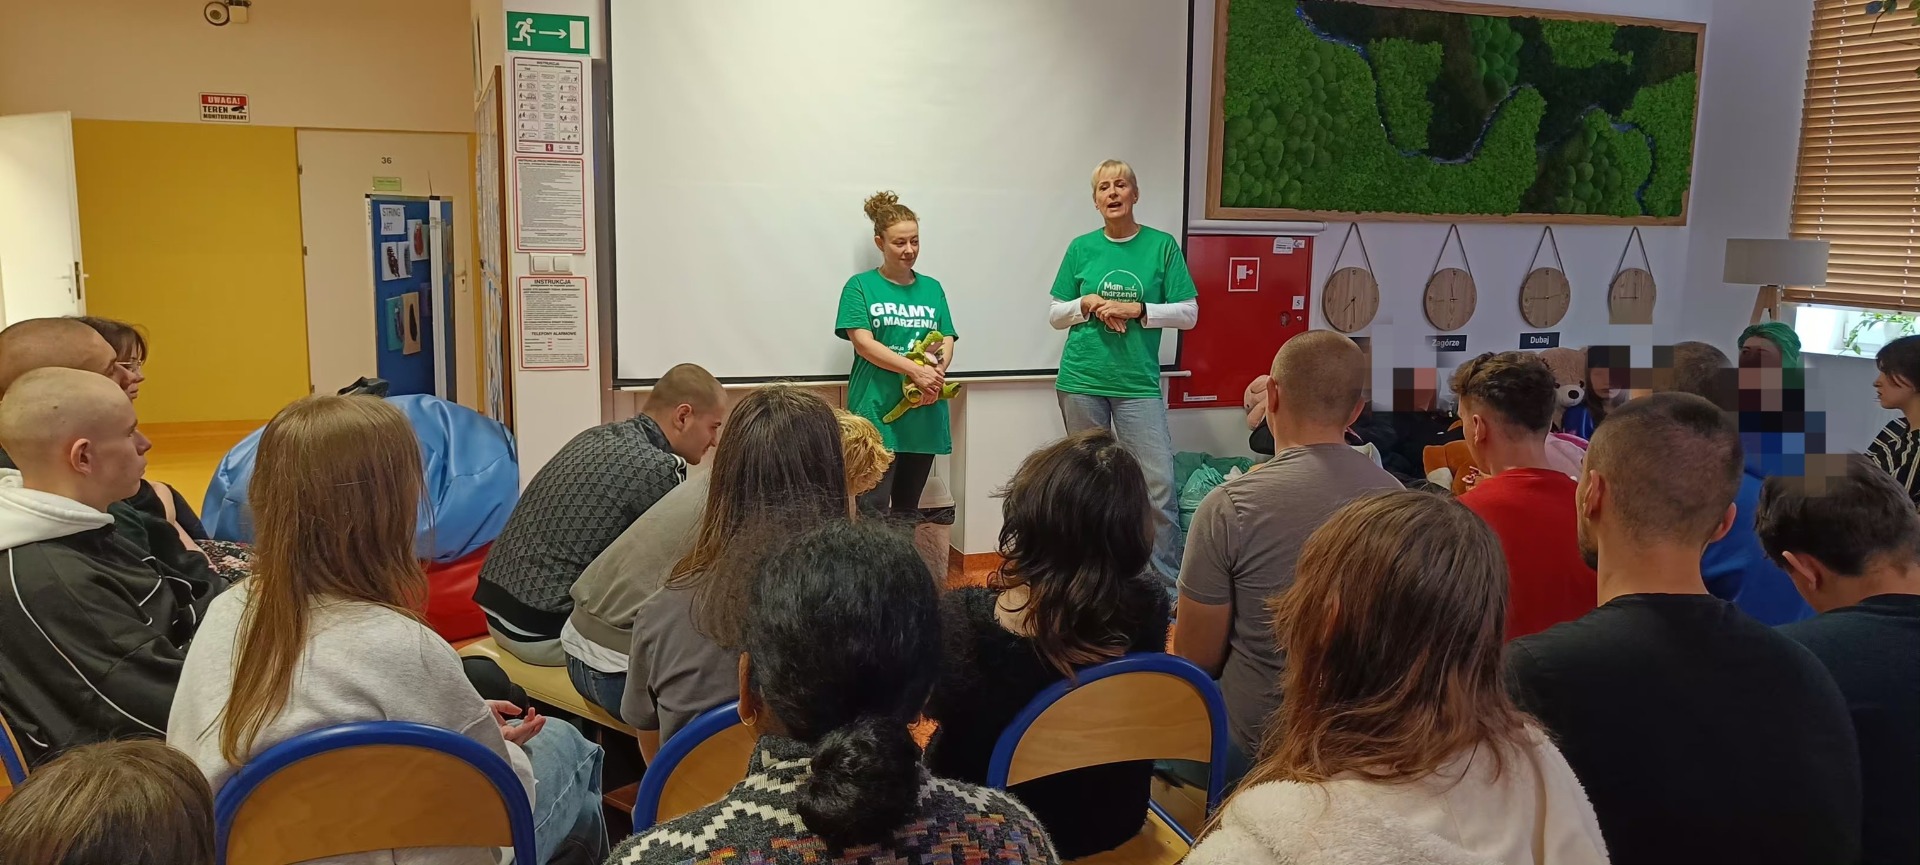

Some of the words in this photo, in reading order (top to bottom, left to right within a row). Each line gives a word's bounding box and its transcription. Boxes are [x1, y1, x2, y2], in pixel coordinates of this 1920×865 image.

[207, 96, 241, 105] UWAGA!
[202, 105, 228, 113] TEREN
[381, 156, 392, 165] 36
[382, 207, 401, 217] STRING
[383, 222, 393, 231] ART
[1103, 281, 1124, 291] Mam
[1101, 290, 1137, 298] marzenia
[870, 302, 936, 319] GRAMY
[872, 318, 881, 328] O
[883, 316, 938, 330] MARZENIA
[1431, 338, 1460, 349] Zagórze
[1530, 335, 1550, 345] Dubaj
